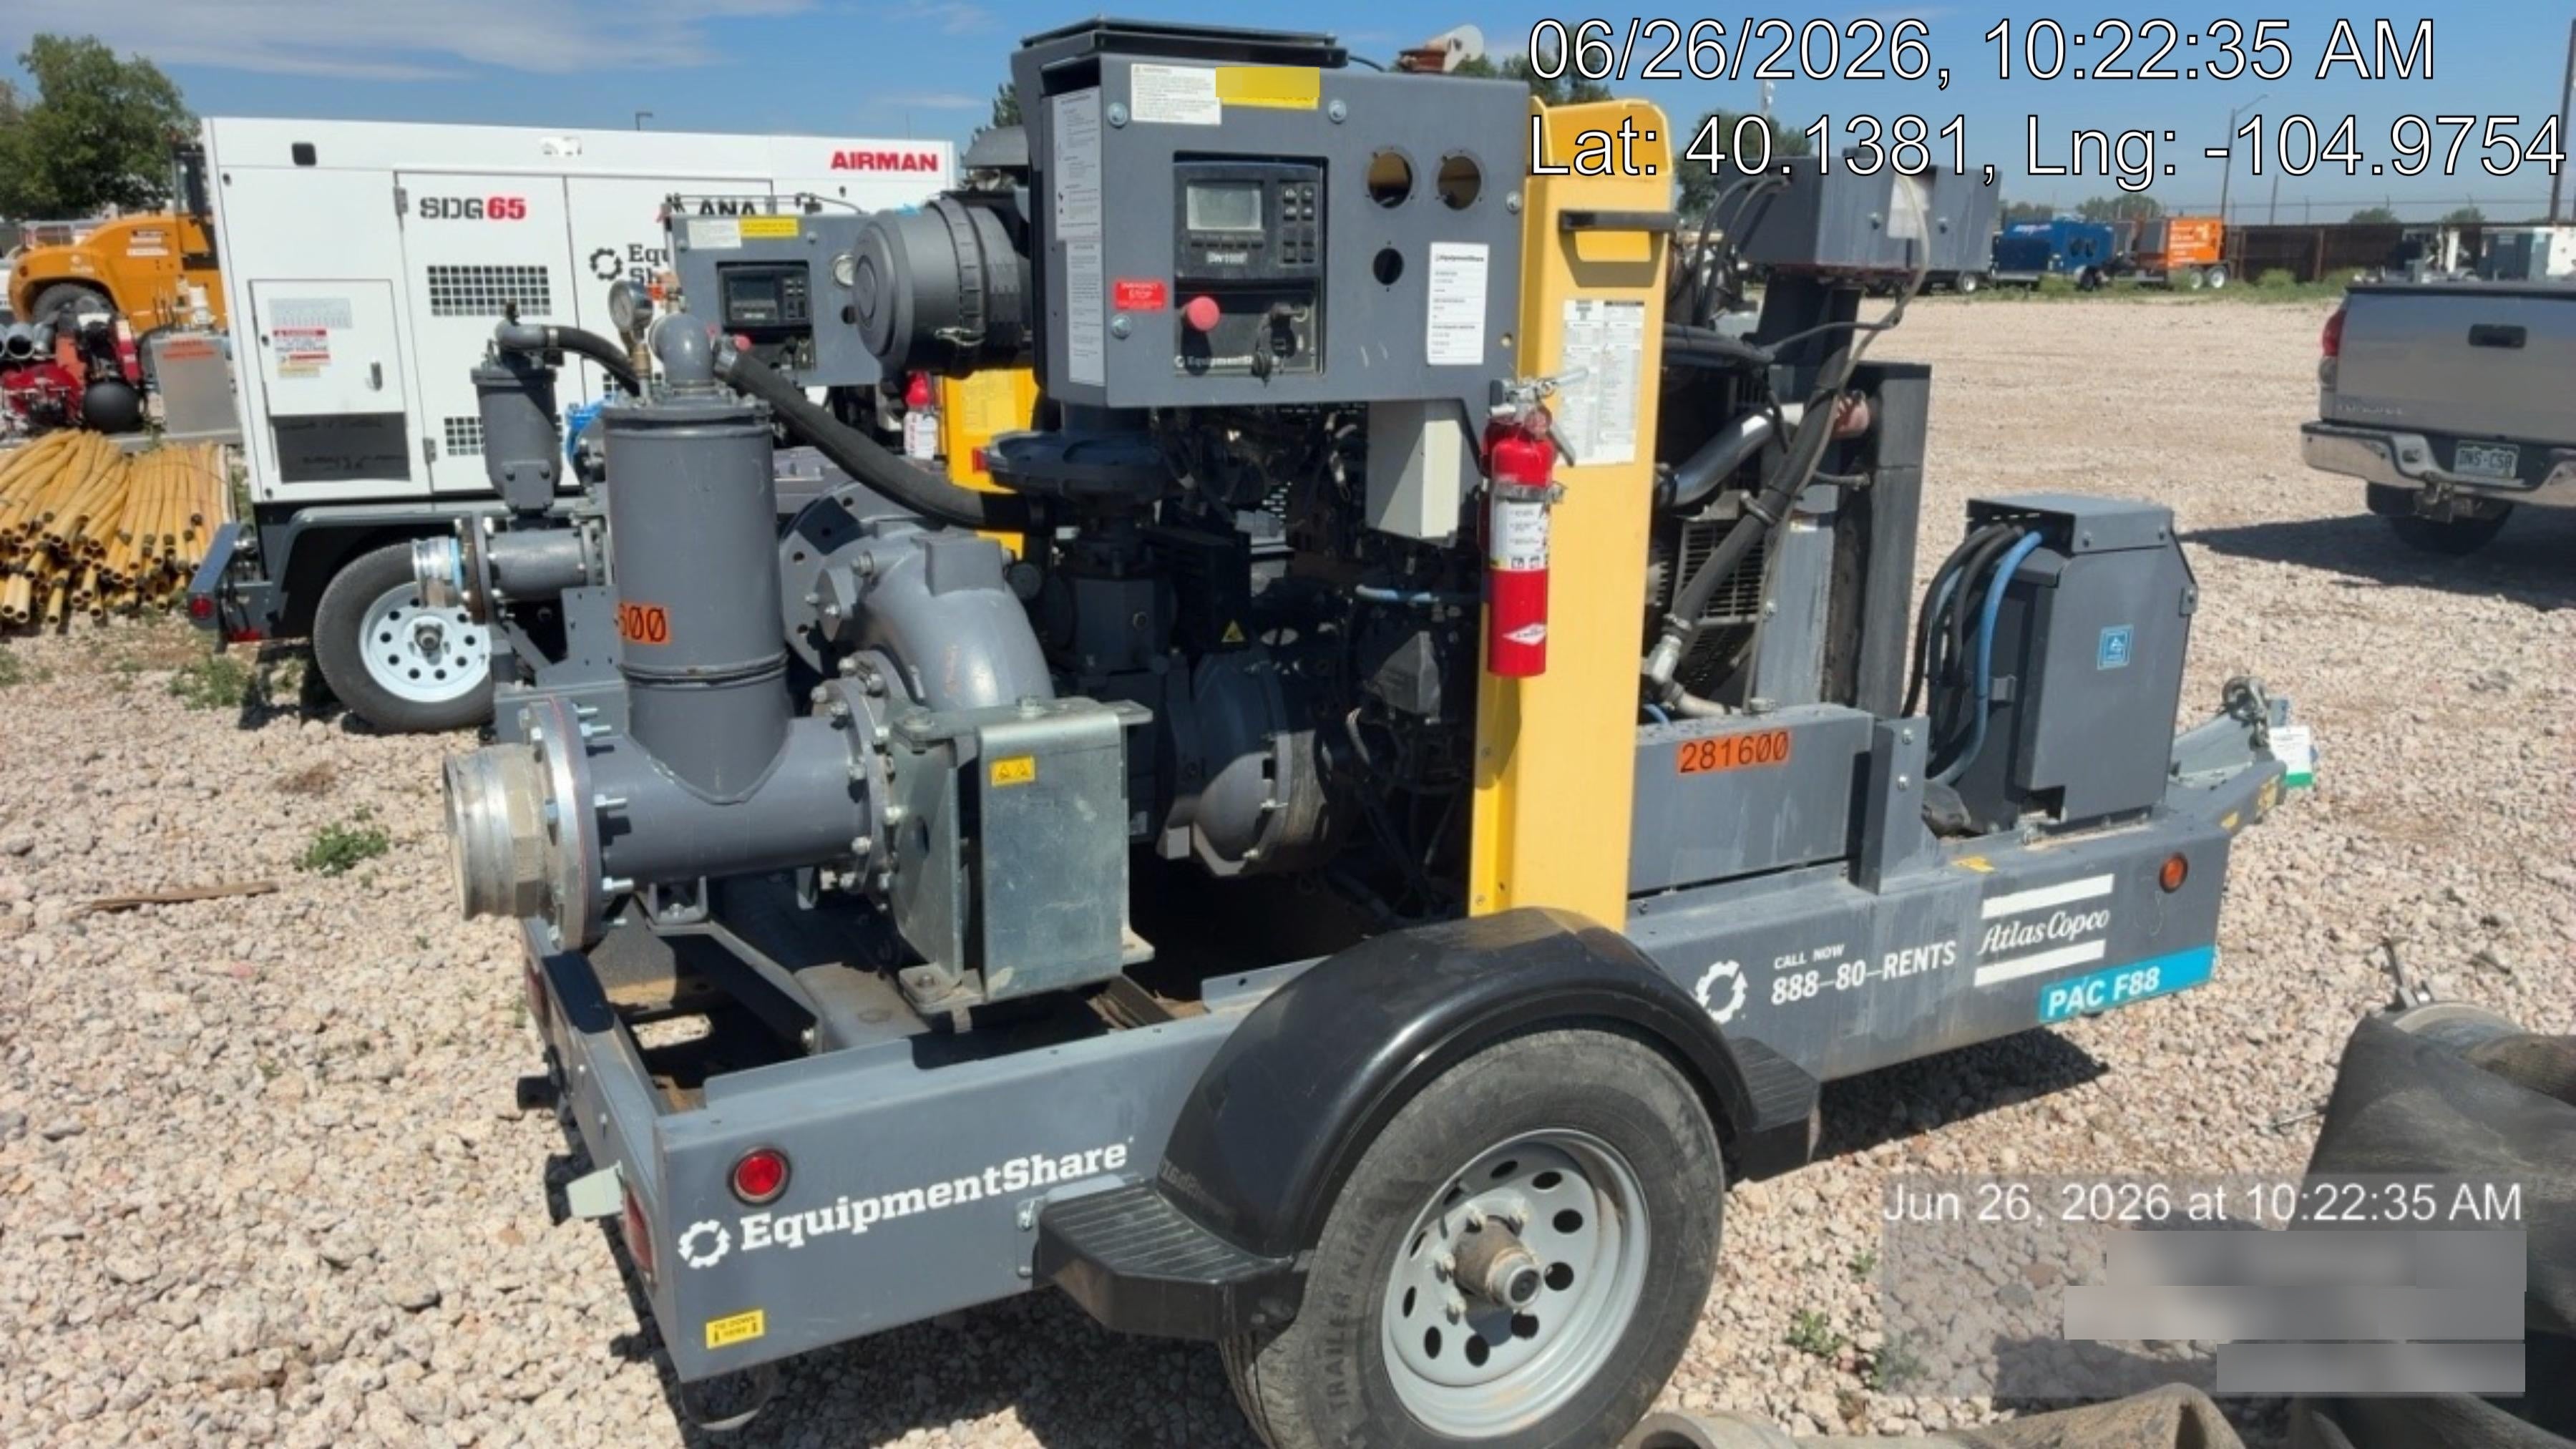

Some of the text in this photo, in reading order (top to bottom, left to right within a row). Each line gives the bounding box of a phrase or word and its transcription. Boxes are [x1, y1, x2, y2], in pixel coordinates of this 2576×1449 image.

[831, 151, 939, 172] AIRMAN
[1680, 731, 1789, 774] 281600
[1774, 944, 1845, 970] CALL NOW
[2047, 966, 2160, 1018] PAC F88
[740, 1143, 1128, 1251] EquipmentShare
